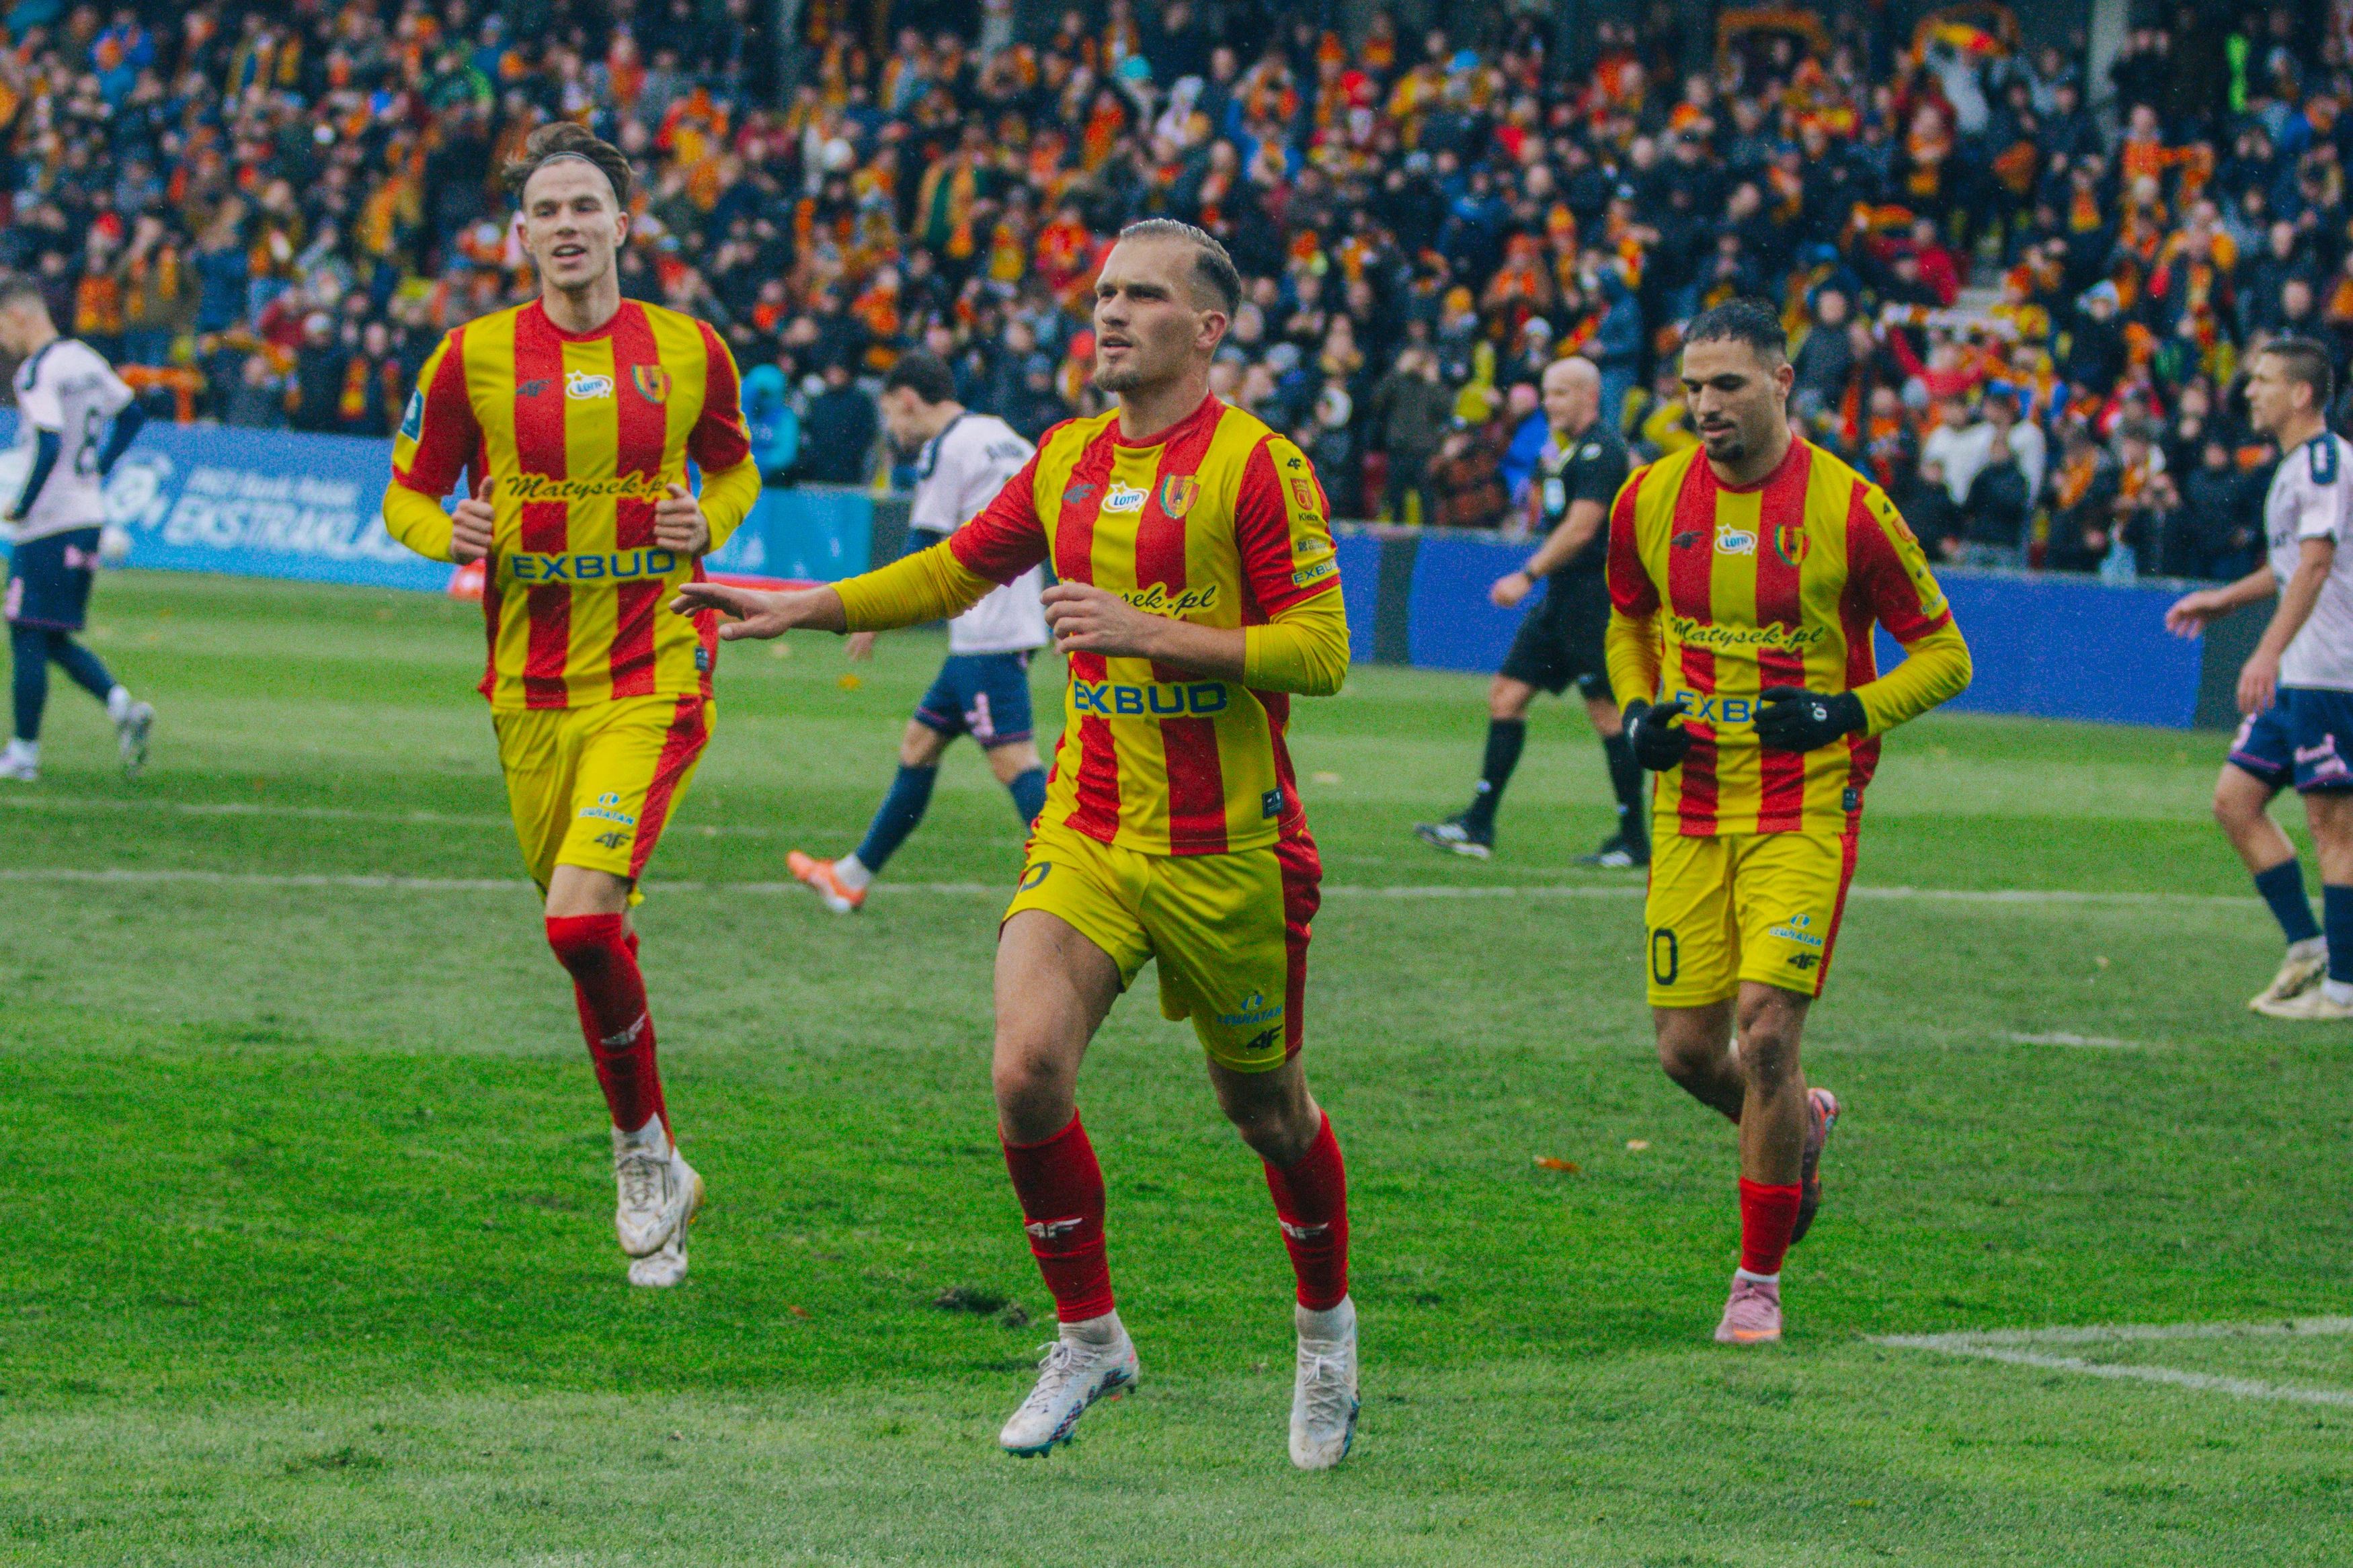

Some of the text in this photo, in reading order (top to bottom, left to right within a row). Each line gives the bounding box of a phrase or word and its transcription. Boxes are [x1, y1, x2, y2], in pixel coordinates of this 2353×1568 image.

[1287, 457, 1301, 470] 4F
[506, 472, 673, 501] Matysek.pl
[1062, 484, 1096, 503] 4F
[1113, 494, 1140, 505] LOTTO
[512, 548, 676, 580] EXBUD
[1121, 585, 1216, 616] sek.pl
[1671, 616, 1824, 648] Matysek.pl
[1074, 680, 1228, 714] EXBUD
[1675, 690, 1763, 723] EXB
[594, 831, 631, 849] 4F
[1652, 928, 1678, 986] 0
[1788, 952, 1821, 970] 4F
[1246, 1024, 1283, 1049] 4F
[1025, 1217, 1082, 1238] 4F
